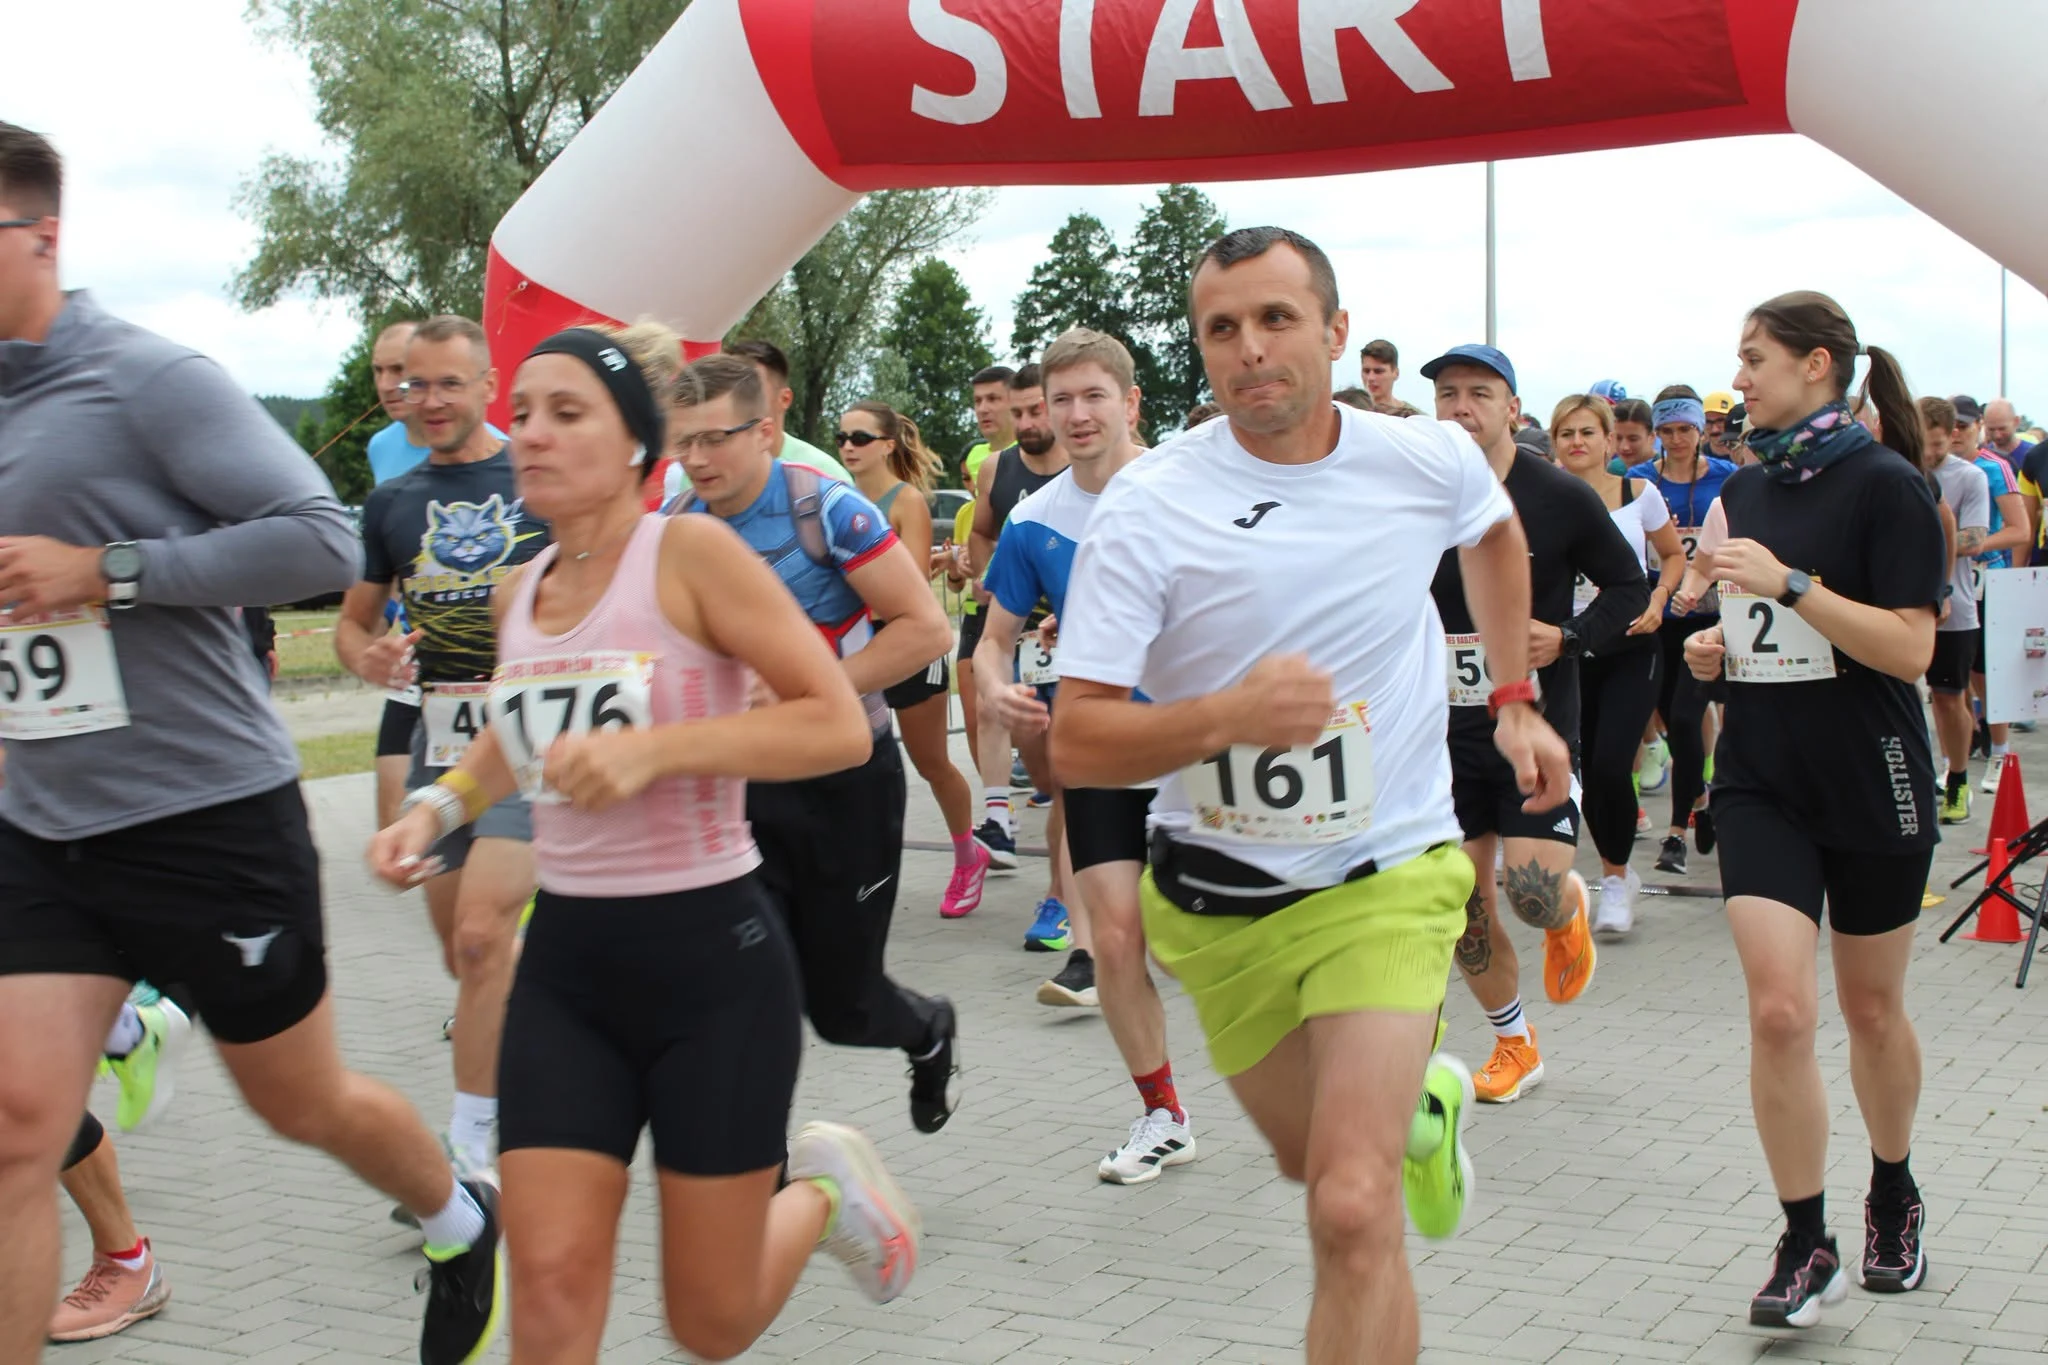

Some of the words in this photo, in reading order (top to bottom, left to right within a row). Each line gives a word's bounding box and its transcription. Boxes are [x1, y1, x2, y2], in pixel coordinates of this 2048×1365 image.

[1748, 601, 1780, 653] 2
[1455, 649, 1494, 687] 5
[453, 701, 488, 741] 4
[502, 680, 637, 767] 176
[1202, 734, 1347, 810] 161
